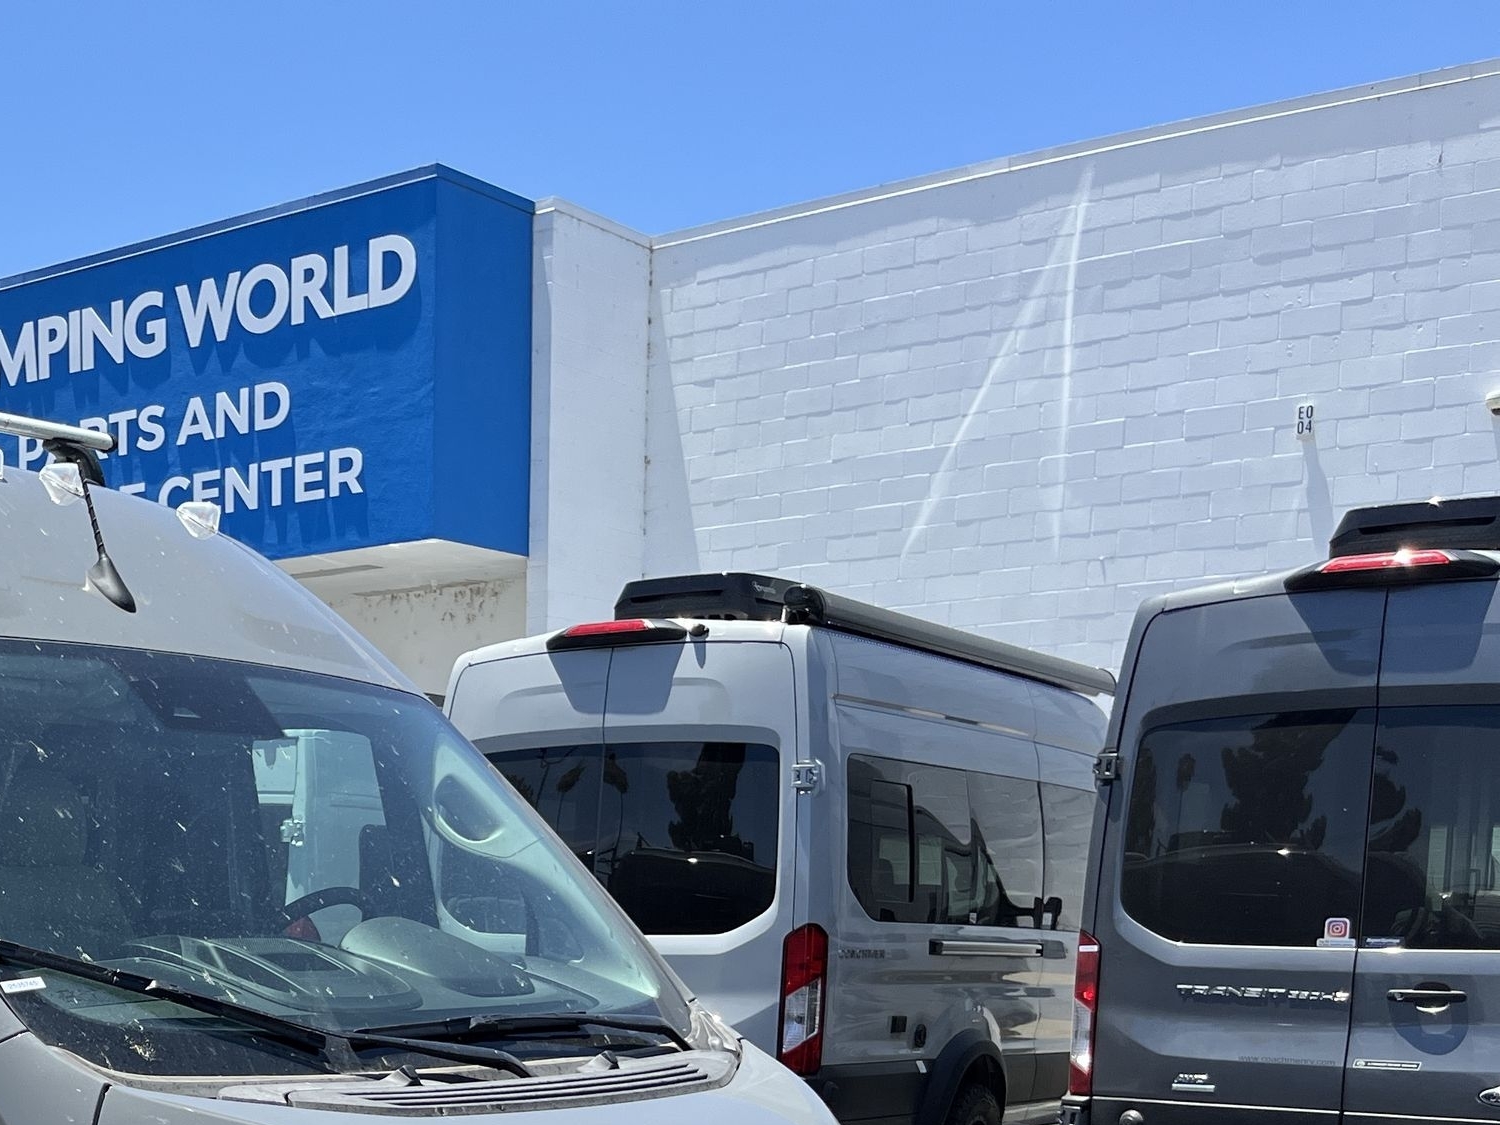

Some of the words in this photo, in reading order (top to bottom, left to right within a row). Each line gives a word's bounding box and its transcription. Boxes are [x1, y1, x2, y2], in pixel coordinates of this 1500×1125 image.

[175, 233, 418, 349] WORLD
[18, 404, 166, 471] PTS
[176, 381, 291, 446] AND
[158, 446, 364, 515] CENTER
